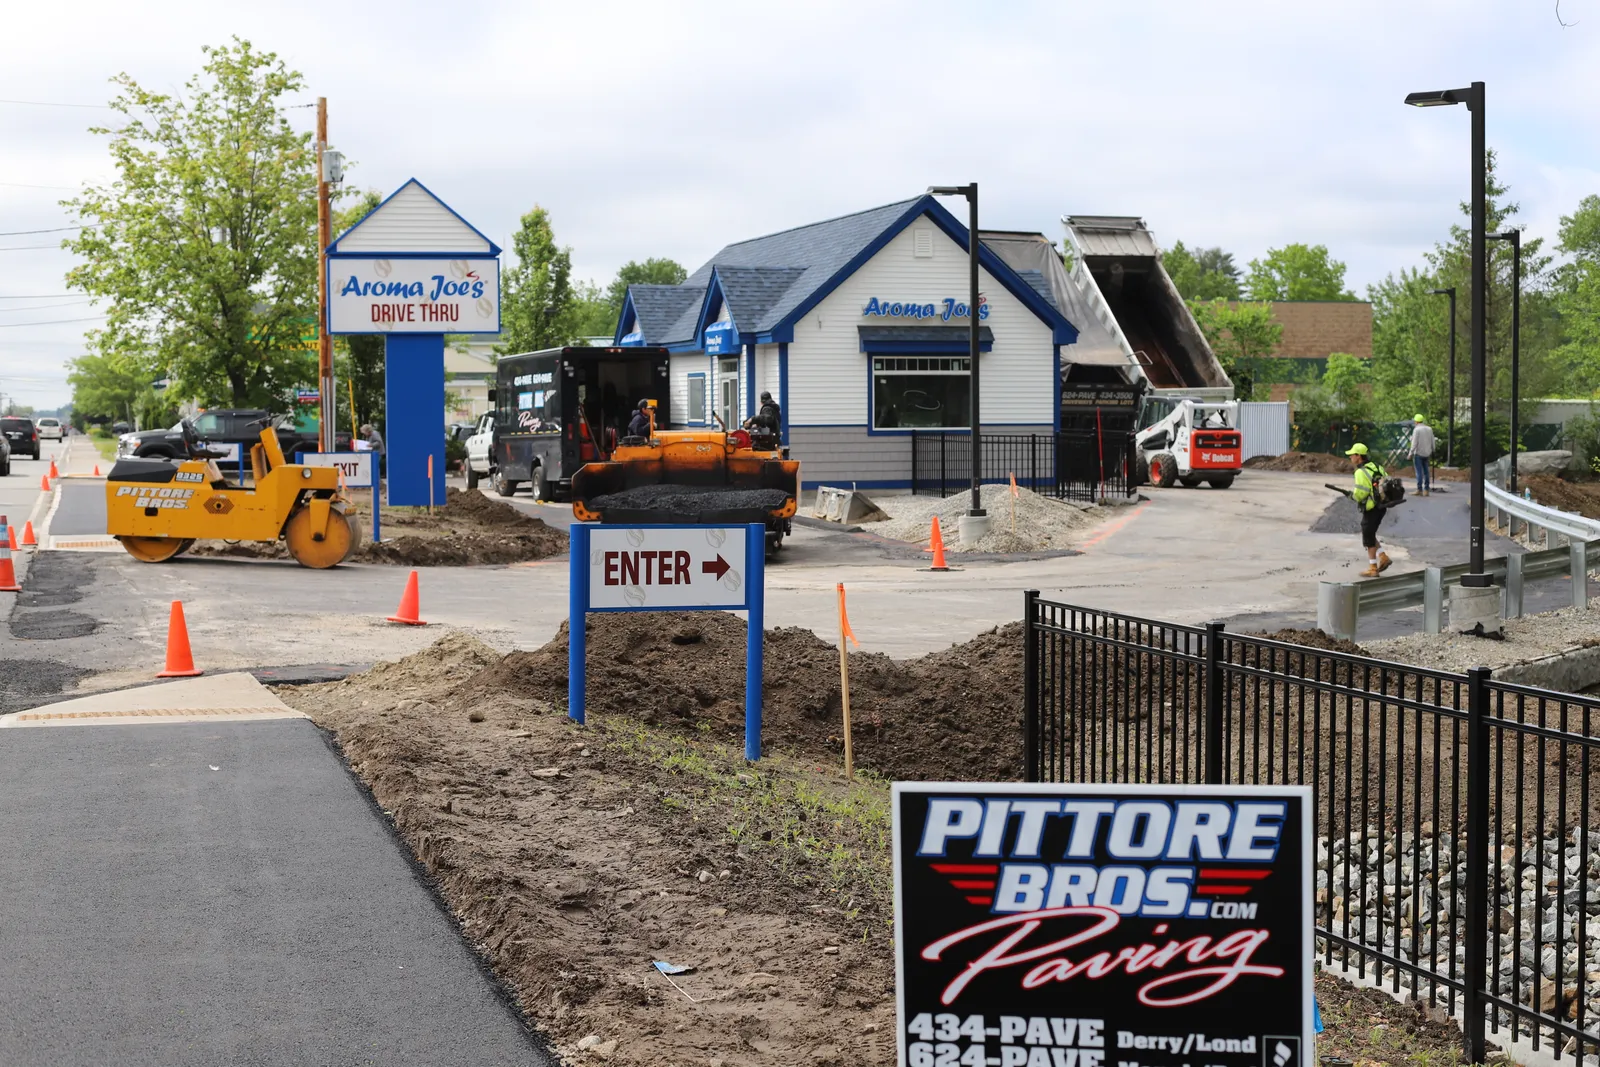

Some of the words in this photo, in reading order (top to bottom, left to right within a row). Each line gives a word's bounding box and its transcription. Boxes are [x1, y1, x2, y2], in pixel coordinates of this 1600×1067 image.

[341, 275, 424, 299] Aroma
[429, 271, 484, 301] Joe's
[371, 303, 415, 323] DRIVE
[419, 303, 459, 322] THRU
[863, 296, 935, 320] Aroma
[115, 486, 195, 499] PITTORE
[134, 497, 189, 509] BROS.
[604, 550, 691, 586] ENTER
[916, 796, 1287, 862] PITTORE
[920, 905, 1284, 1007] Paving
[907, 1012, 1105, 1047] 434-PAVE
[908, 1041, 1106, 1067] 624-PAVE
[1116, 1031, 1257, 1055] Derry/Lond
